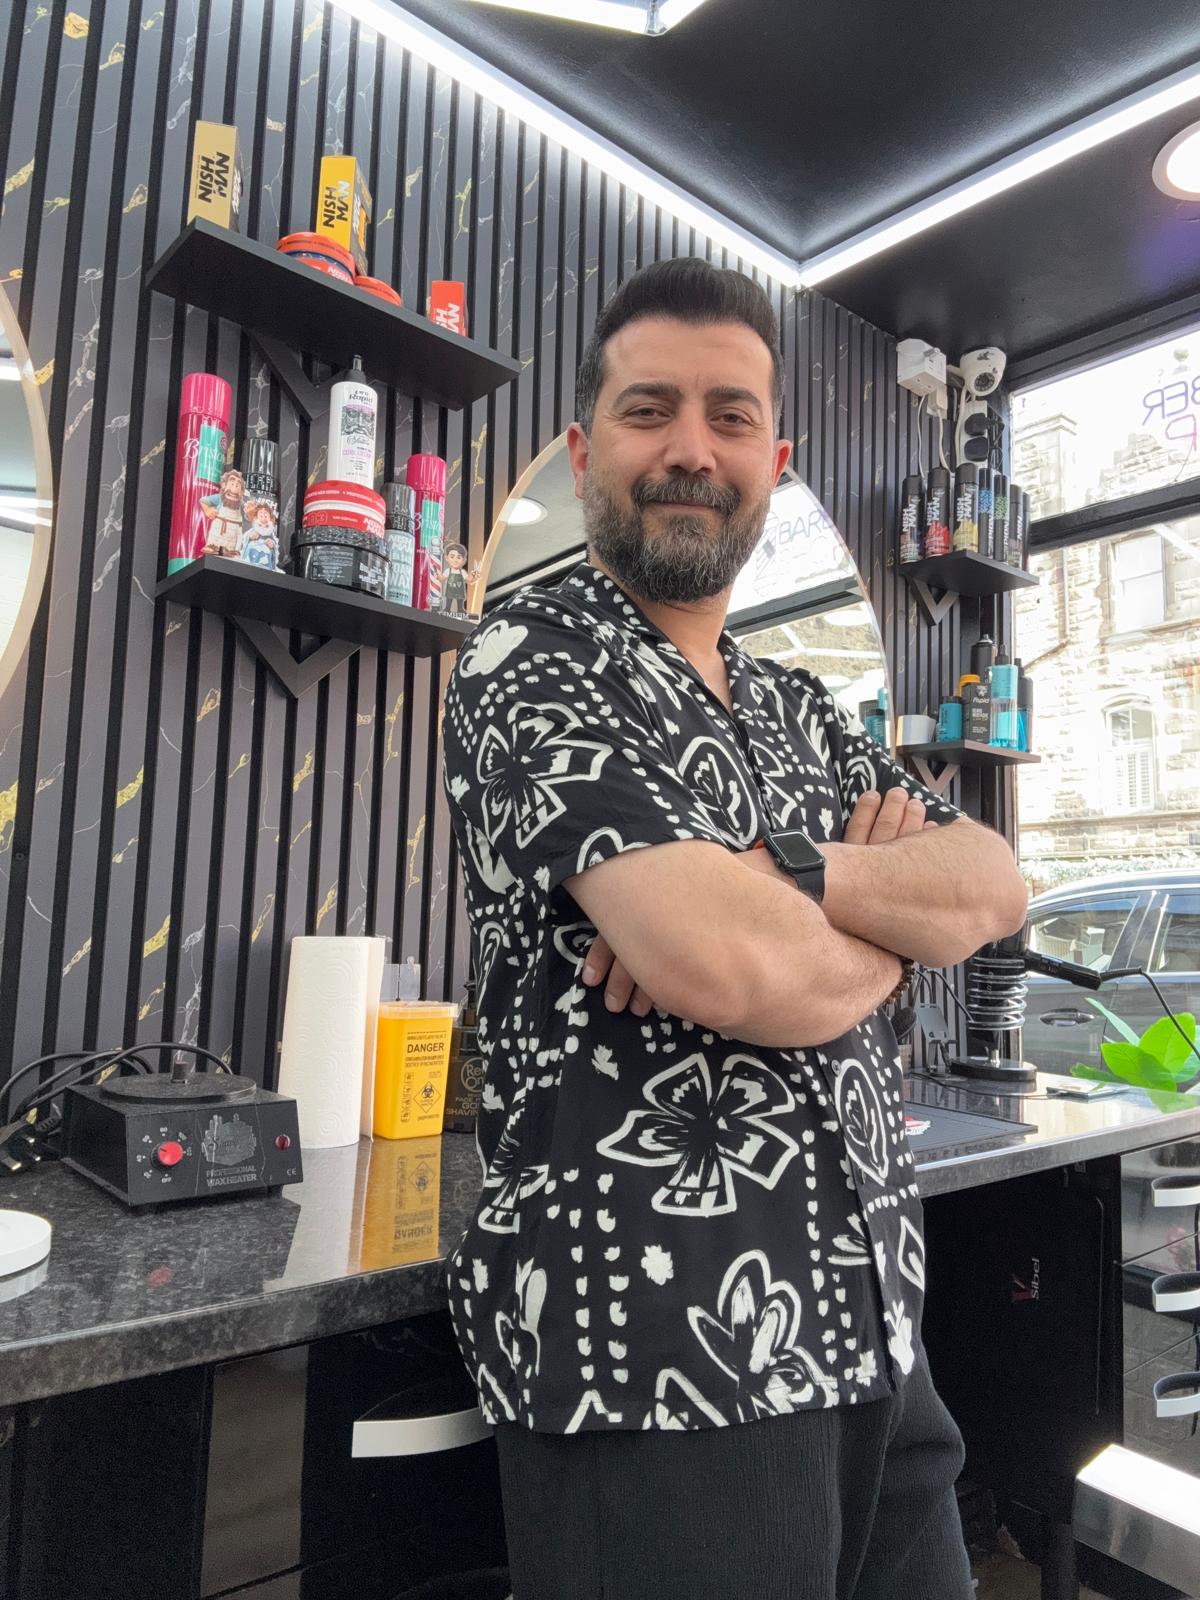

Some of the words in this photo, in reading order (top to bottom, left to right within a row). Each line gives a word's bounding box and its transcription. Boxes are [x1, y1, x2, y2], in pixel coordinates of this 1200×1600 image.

[198, 155, 215, 203] NISH
[323, 186, 336, 228] NISH
[407, 1042, 444, 1054] DANGER
[466, 1064, 482, 1077] Re
[465, 1076, 484, 1090] On
[206, 1177, 226, 1187] WAX
[226, 1173, 257, 1185] HEATER
[1031, 1258, 1040, 1300] Sibel
